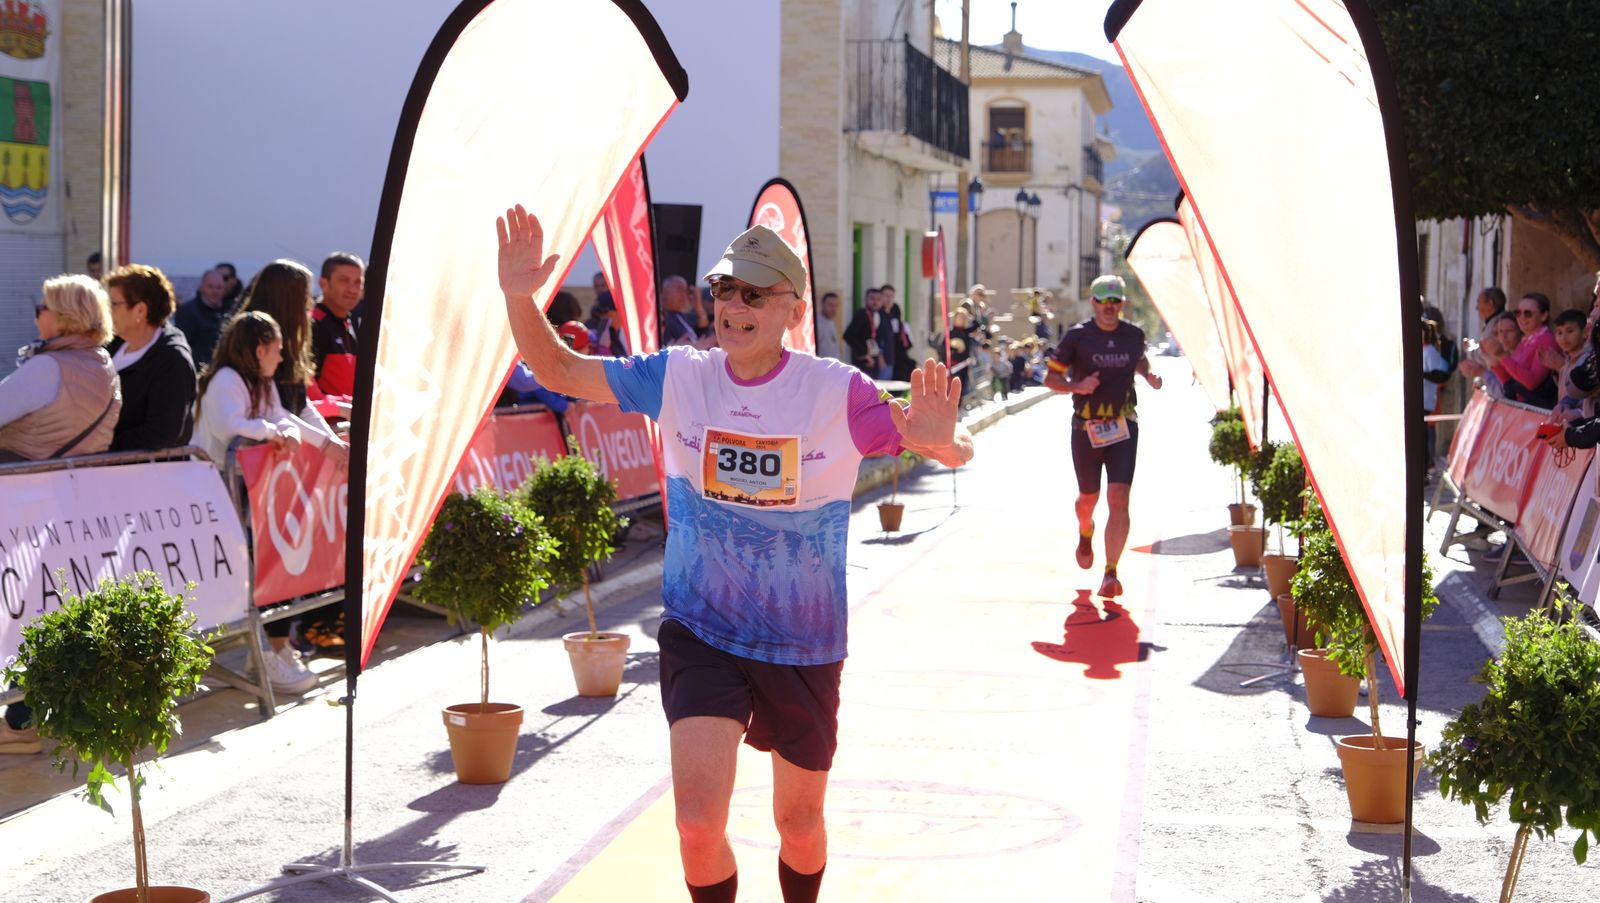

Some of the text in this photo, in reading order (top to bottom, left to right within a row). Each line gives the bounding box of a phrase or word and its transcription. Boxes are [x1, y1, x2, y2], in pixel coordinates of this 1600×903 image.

[718, 448, 781, 476] 380
[190, 502, 220, 525] DE
[2, 534, 233, 619] CANTORIA
